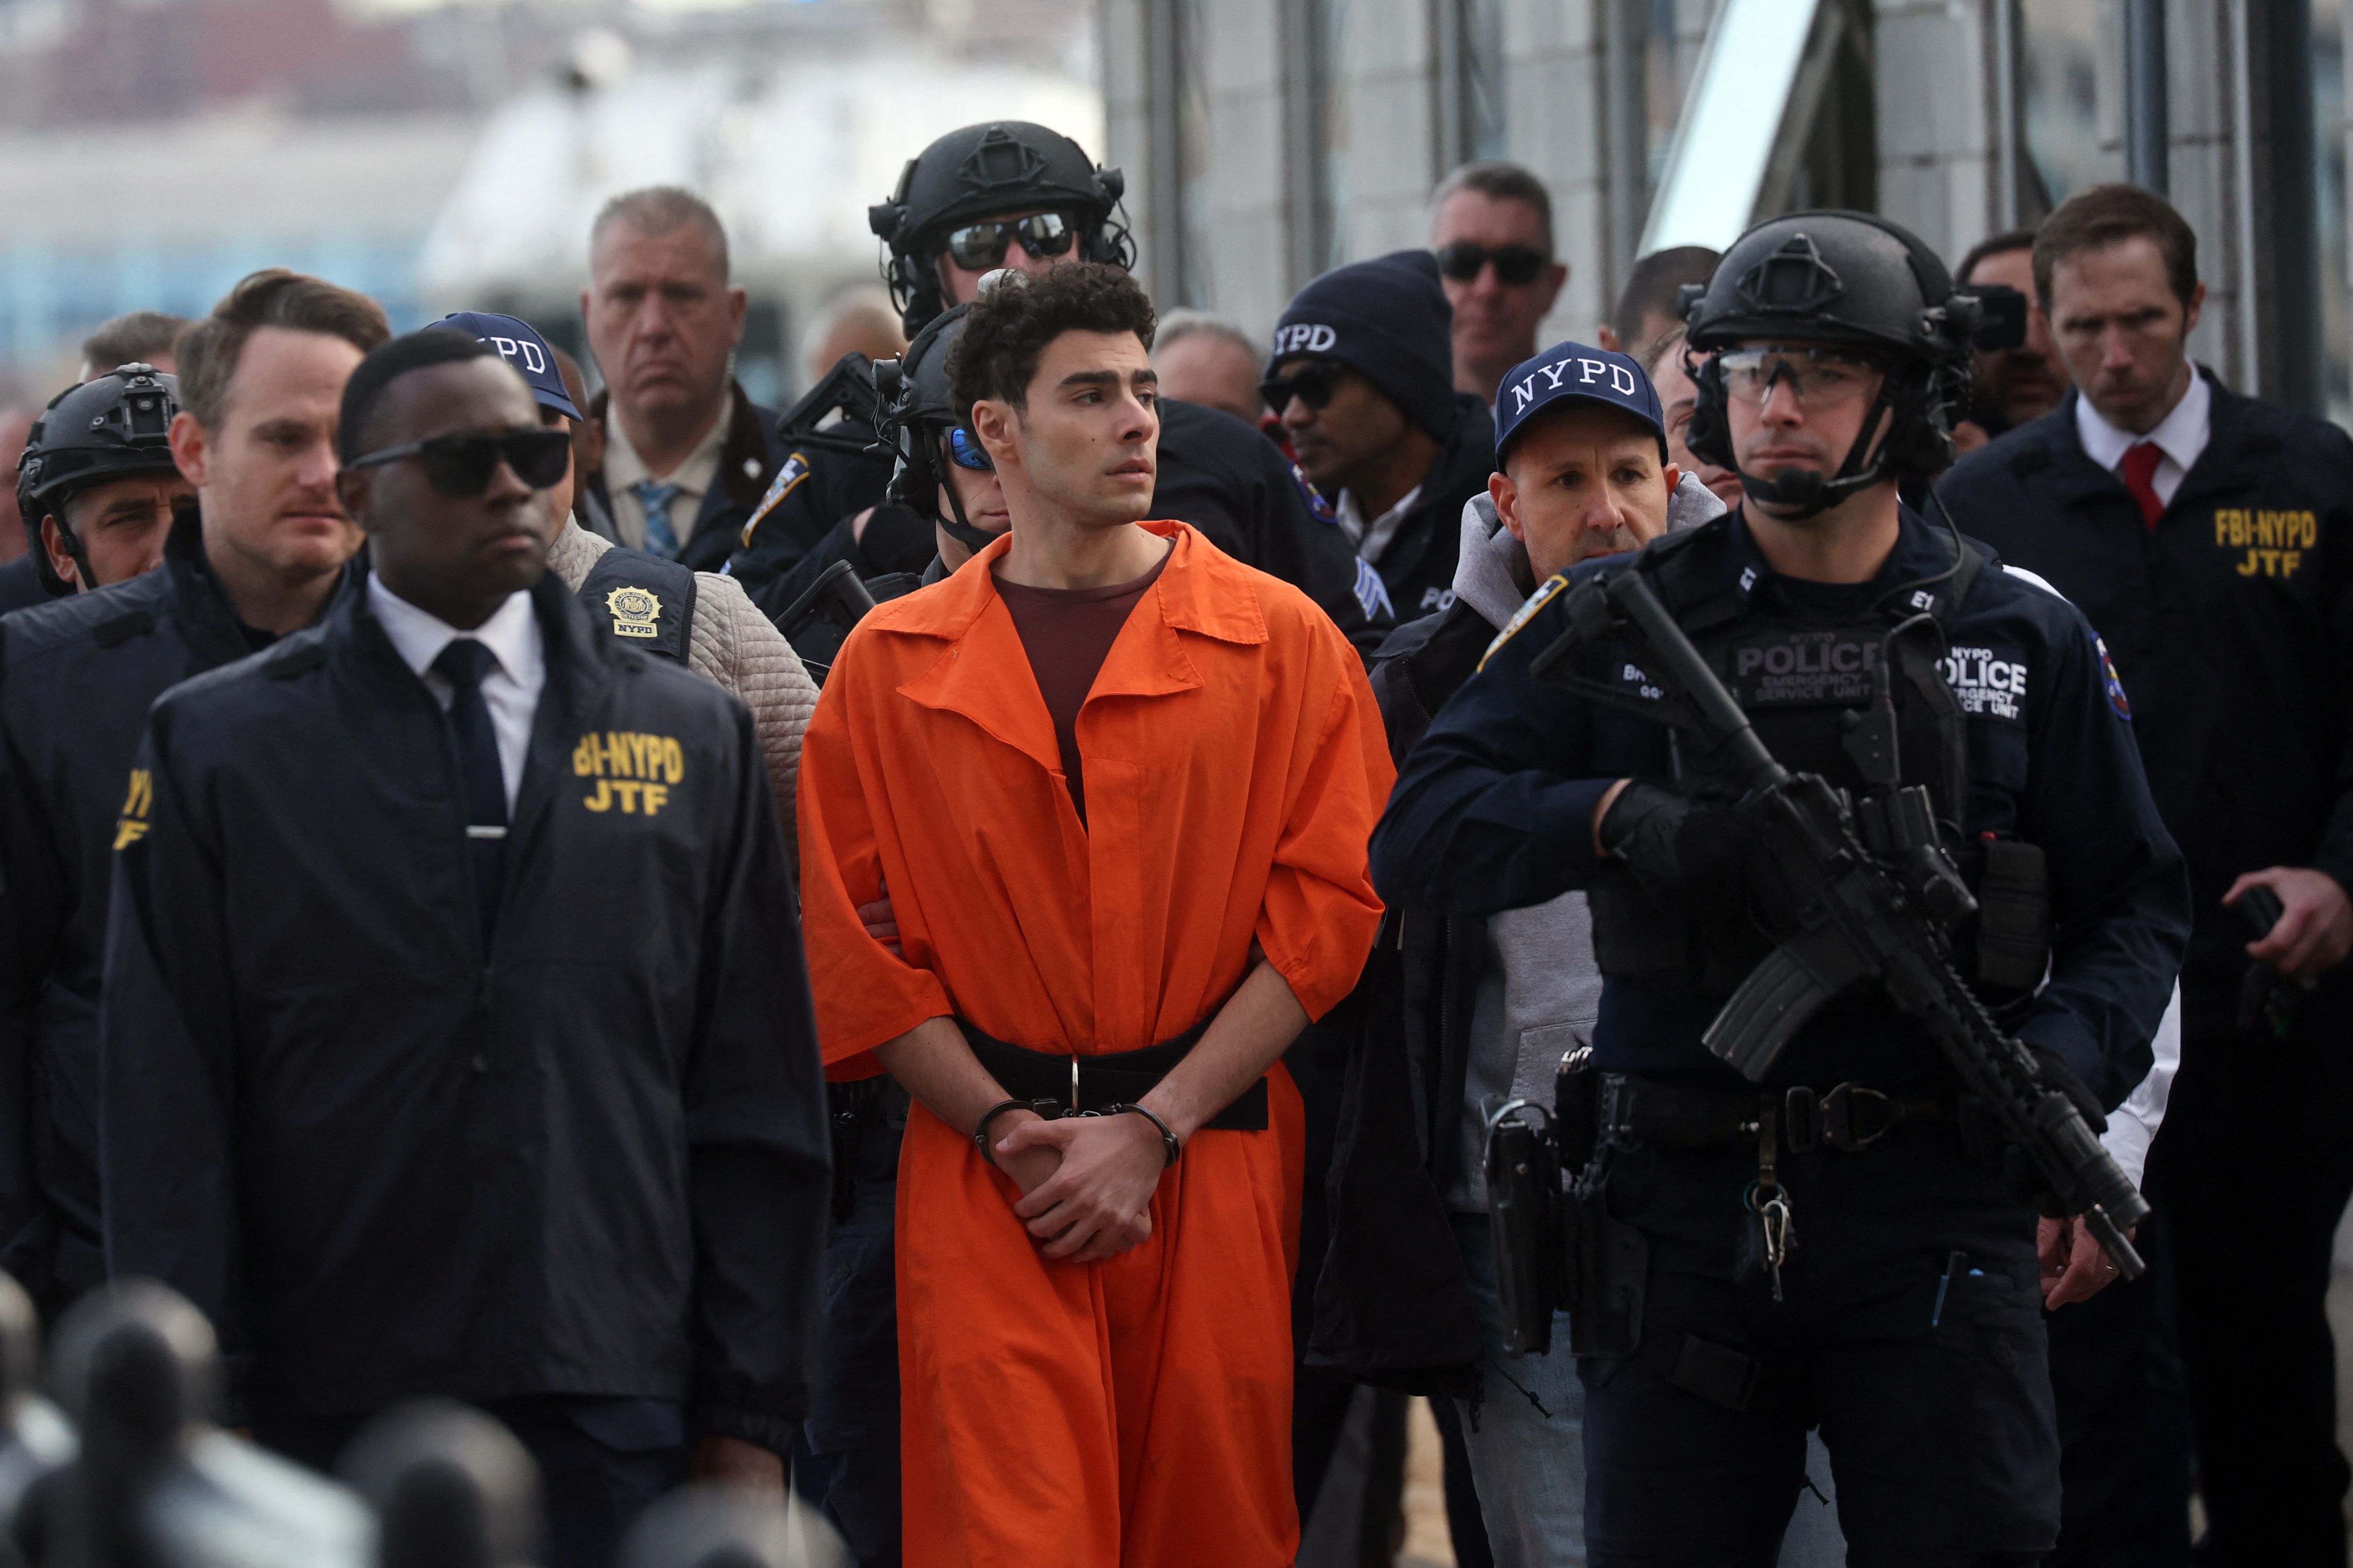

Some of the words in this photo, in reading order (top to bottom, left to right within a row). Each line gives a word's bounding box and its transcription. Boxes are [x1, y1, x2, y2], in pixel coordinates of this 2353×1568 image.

[1273, 323, 1336, 355] YPD
[476, 337, 545, 374] PD
[1511, 358, 1635, 416] NYPD
[2215, 508, 2317, 549] FBI-NYPD
[2236, 548, 2302, 579] JTF
[1420, 586, 1457, 611] PO
[1910, 590, 1935, 611] E1
[618, 624, 652, 633] NYPD
[1952, 646, 1993, 662] NYPD
[1833, 684, 1872, 698] UNIT
[1934, 657, 2027, 696] OLICE
[1954, 687, 2014, 705] RGENCY
[1991, 698, 2019, 720] UNIT
[572, 731, 684, 784] BI-NYPD
[583, 779, 669, 816] JTF
